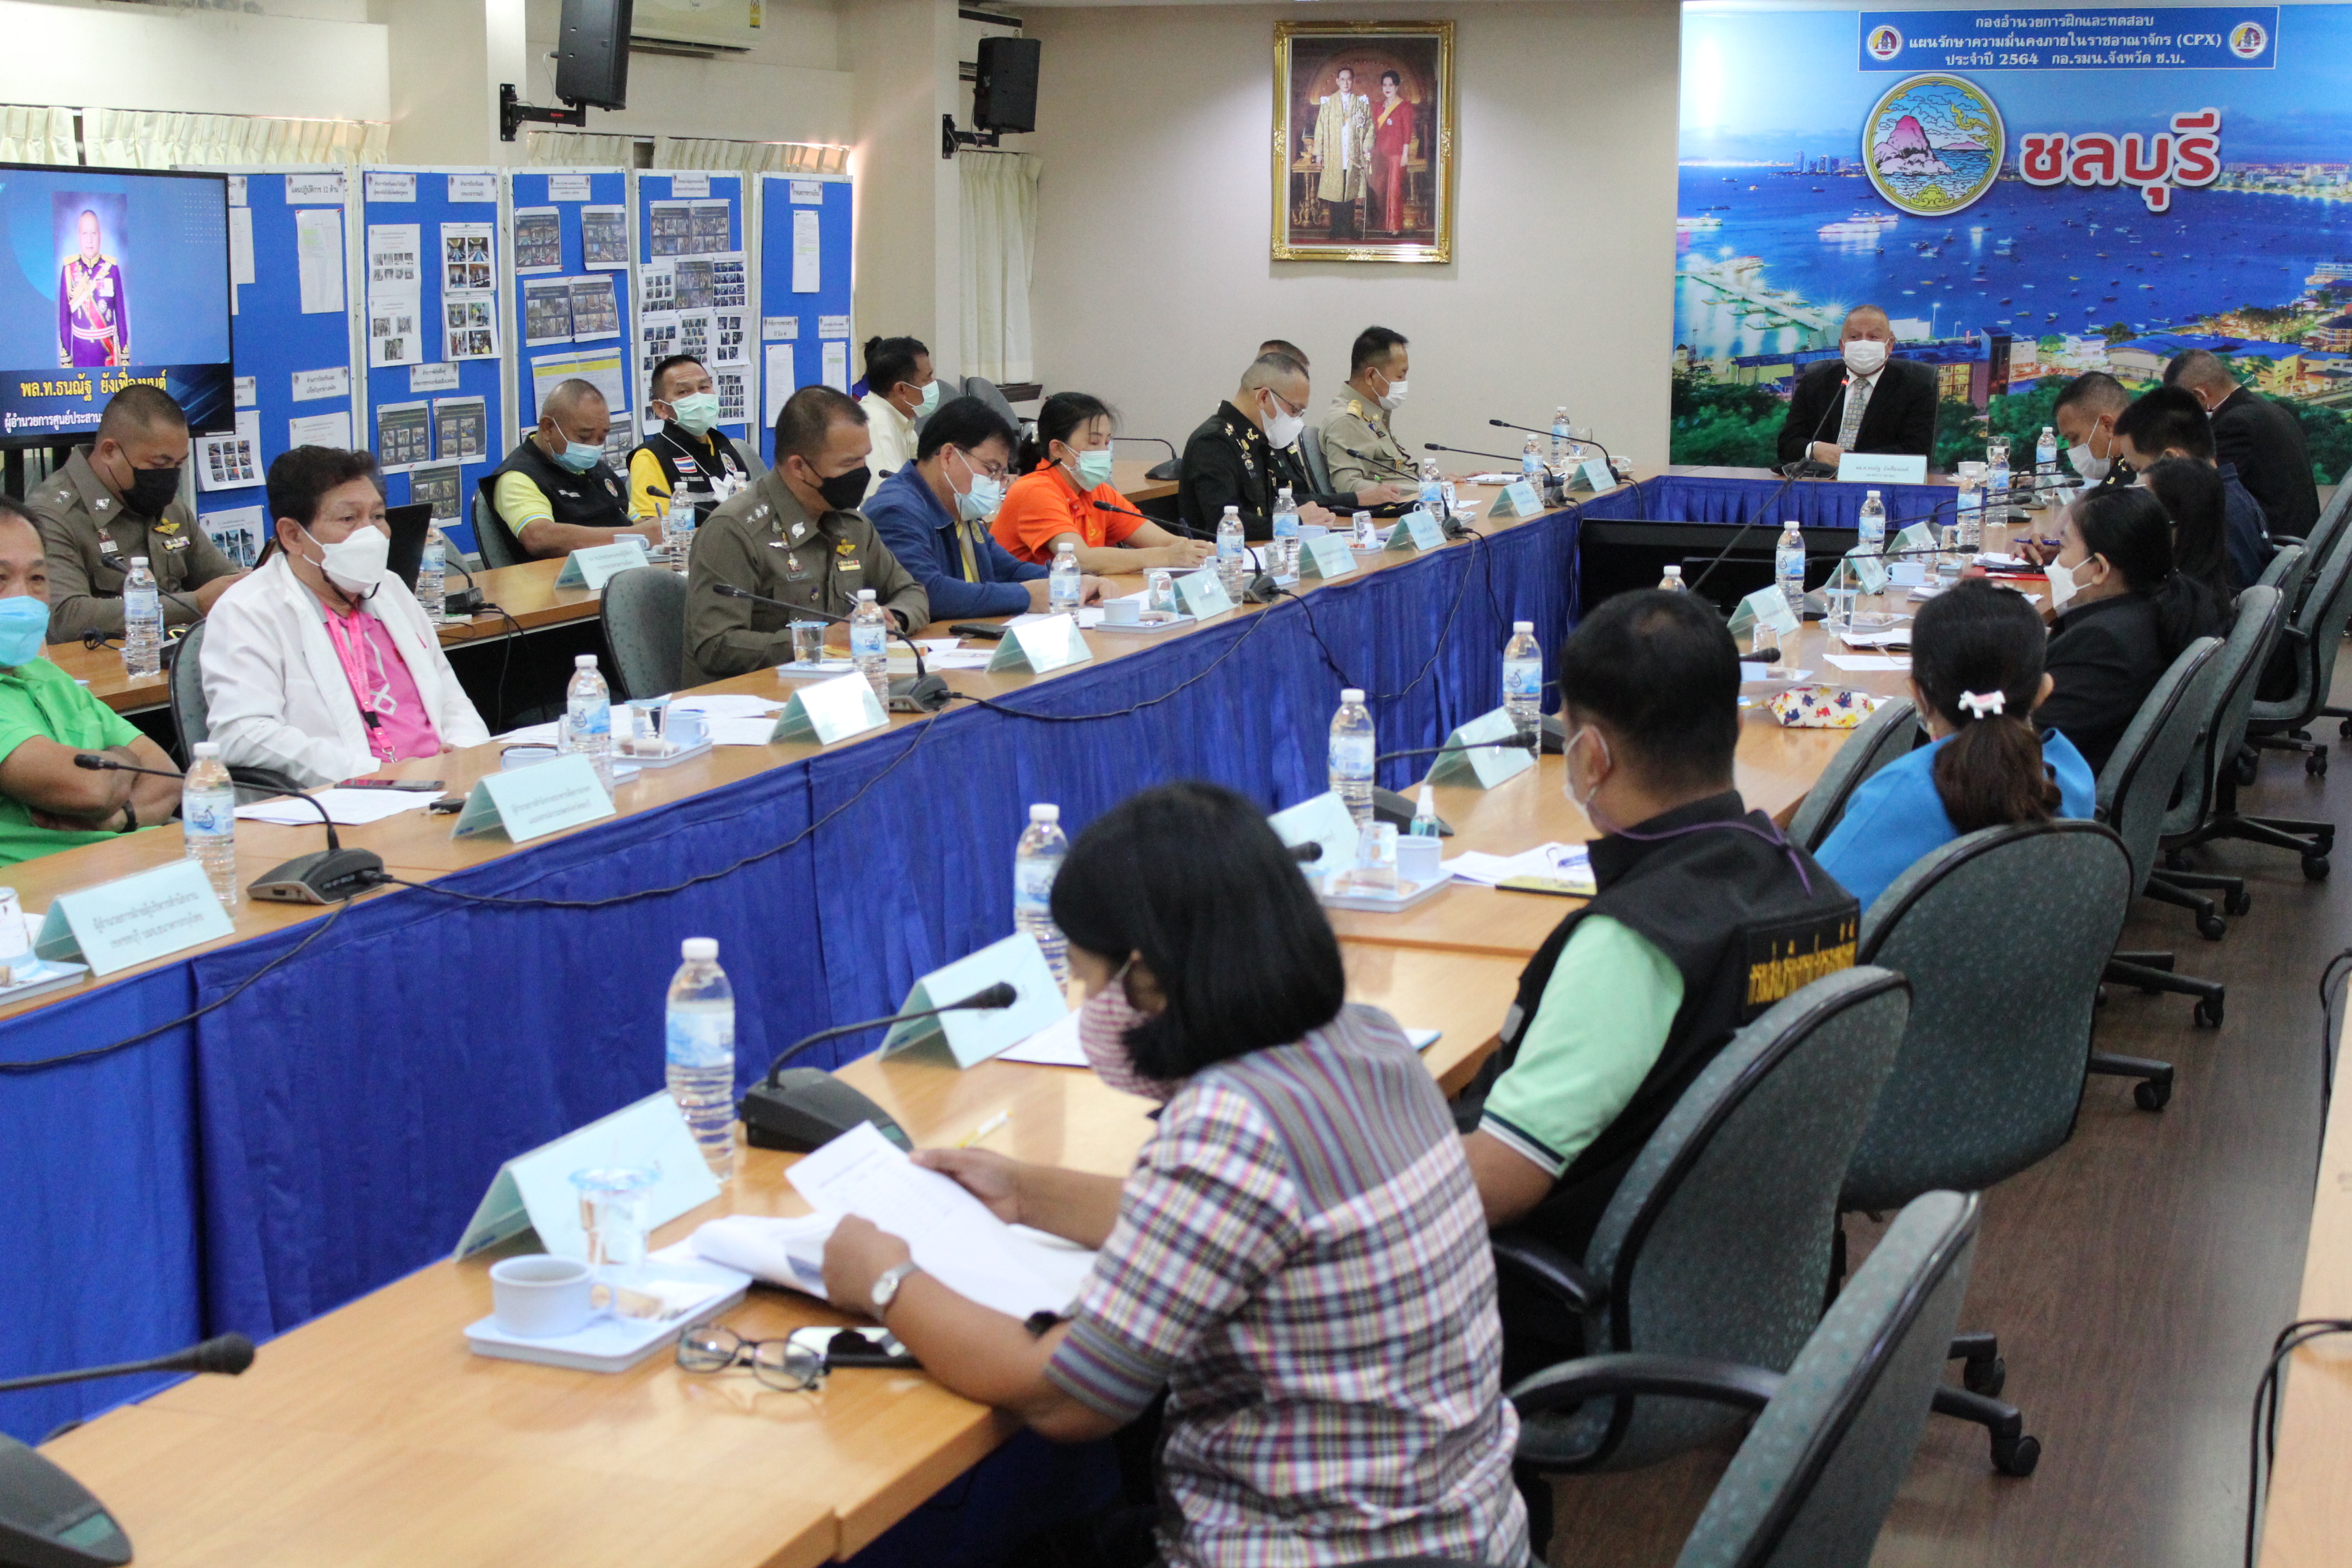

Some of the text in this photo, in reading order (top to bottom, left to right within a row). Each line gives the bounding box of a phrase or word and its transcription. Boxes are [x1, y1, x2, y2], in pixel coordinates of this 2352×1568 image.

[1975, 14, 2154, 29] กองอำนวยการฝึกและทดสอบ
[1909, 33, 2172, 48] แผนรักษาความมั่นคงภายในราชอาณาจักร
[2177, 33, 2222, 48] (CPX)
[1945, 51, 2186, 66] ประจำปี 2564 กอ.รมน.จังหวัด ช.บ.
[2021, 109, 2219, 210] ชลบุรี
[20, 372, 92, 401] พล.ท.ธนณัฐ
[4, 409, 103, 433] ผู้อำนวยการศูนย์ประสาน
